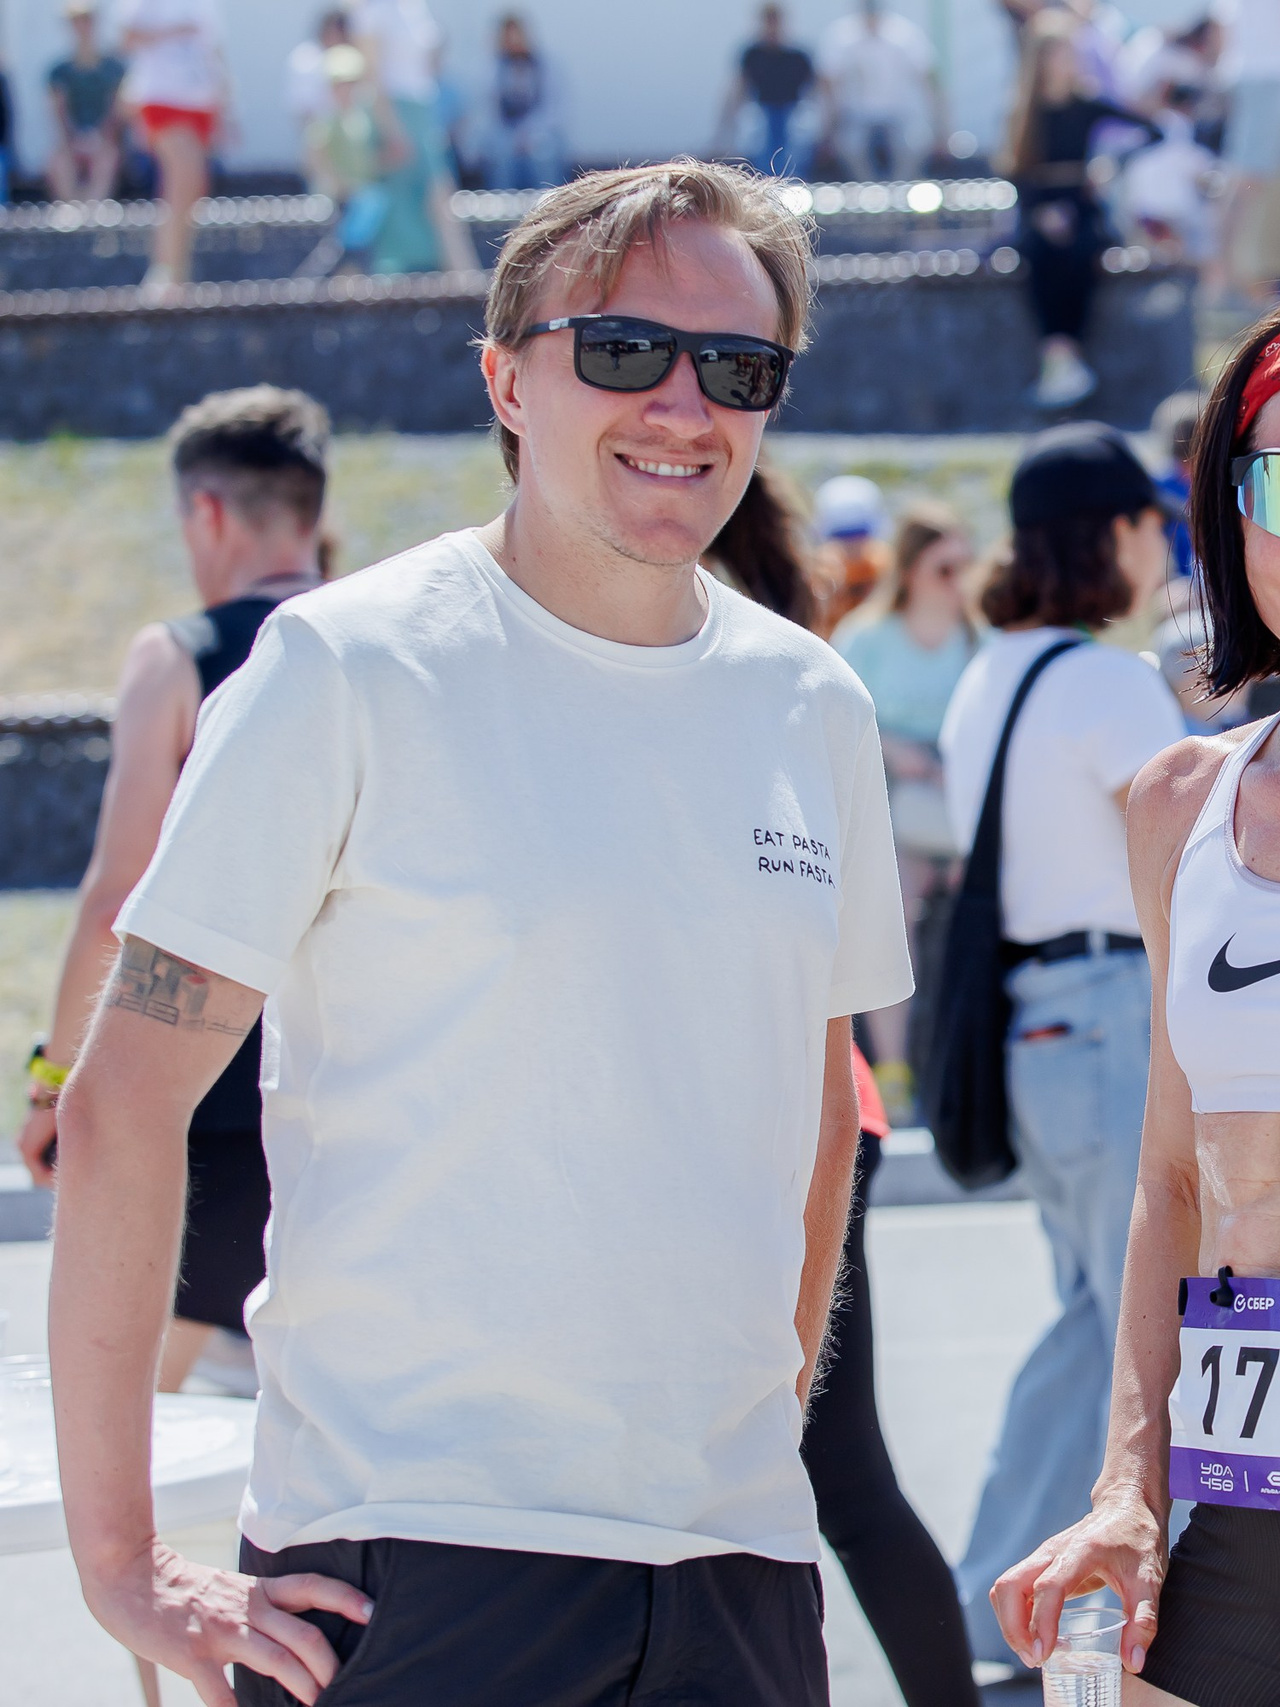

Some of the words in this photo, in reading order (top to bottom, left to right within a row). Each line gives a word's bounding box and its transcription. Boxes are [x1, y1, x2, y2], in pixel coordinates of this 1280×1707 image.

[753, 828, 785, 847] EAT
[792, 834, 831, 860] PASTA
[758, 856, 794, 874] RUN
[799, 860, 836, 889] FASTA
[1247, 1297, 1275, 1310] СБЕР
[1200, 1462, 1234, 1478] УФА
